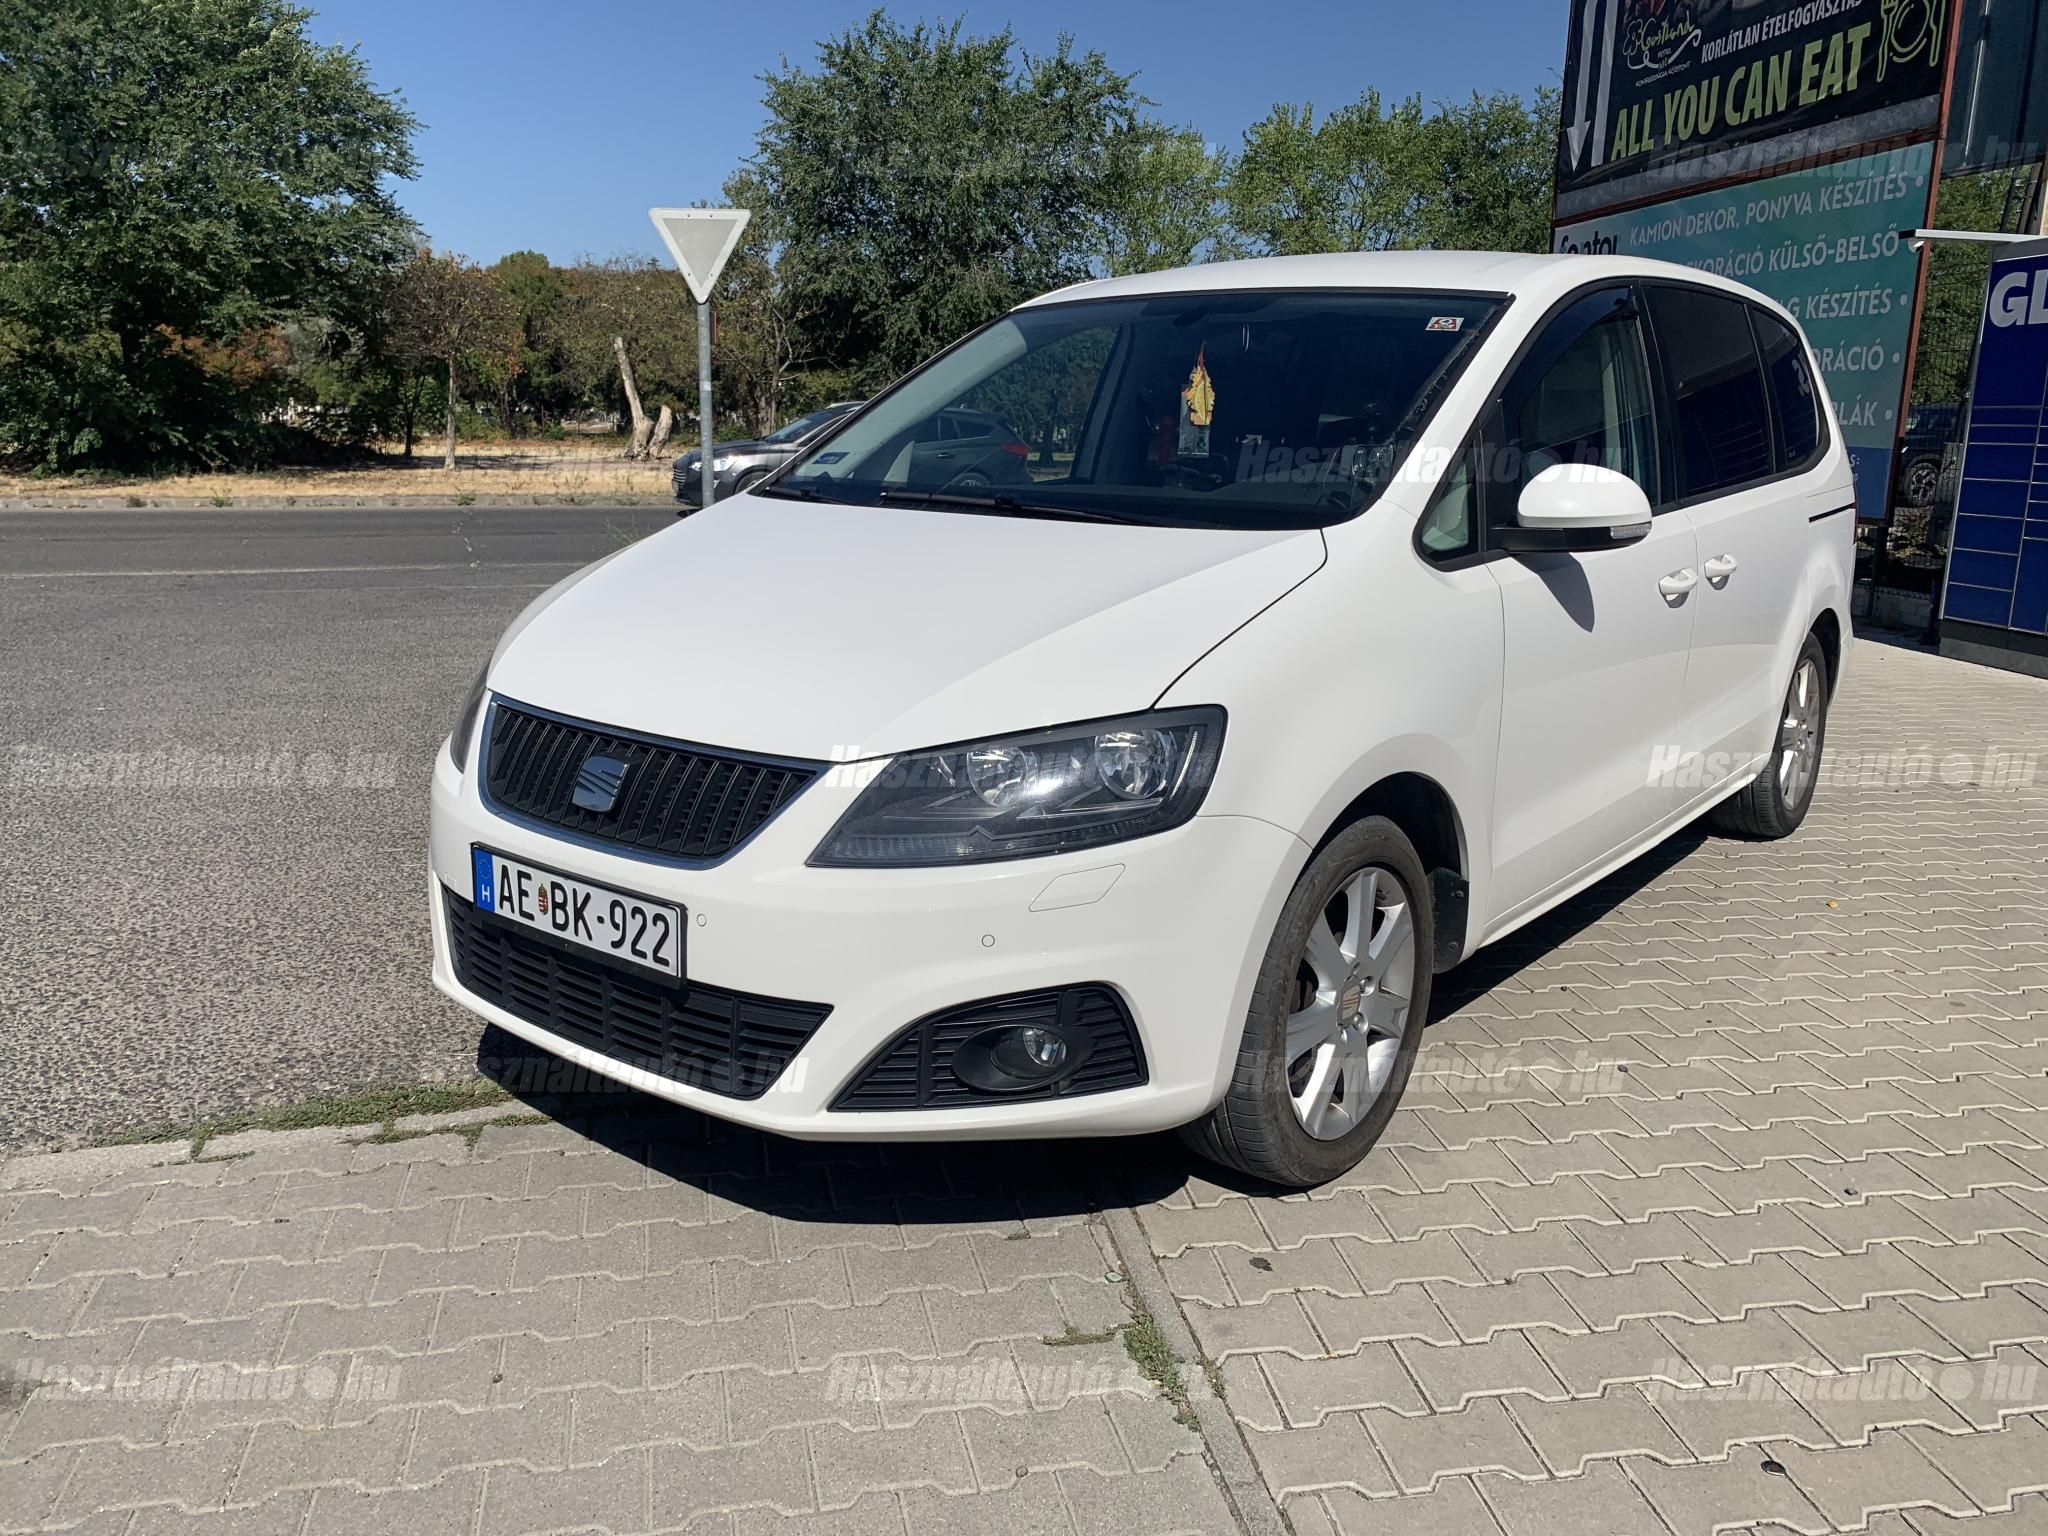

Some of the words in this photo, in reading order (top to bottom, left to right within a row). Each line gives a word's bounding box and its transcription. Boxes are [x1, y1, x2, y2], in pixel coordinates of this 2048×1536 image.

[1701, 25, 1760, 64] KORLÁTLAN
[1611, 98, 1654, 161] ALL
[1664, 75, 1719, 146] YOU
[1725, 50, 1792, 126] CAN
[1799, 22, 1871, 106] EAT
[1630, 216, 1682, 247] KAMION
[1745, 191, 1813, 225] PONYVA
[1819, 166, 1908, 212] KÉSZÍTÉS
[1805, 282, 1893, 320] KÉSZÍTÉS
[481, 884, 491, 903] H
